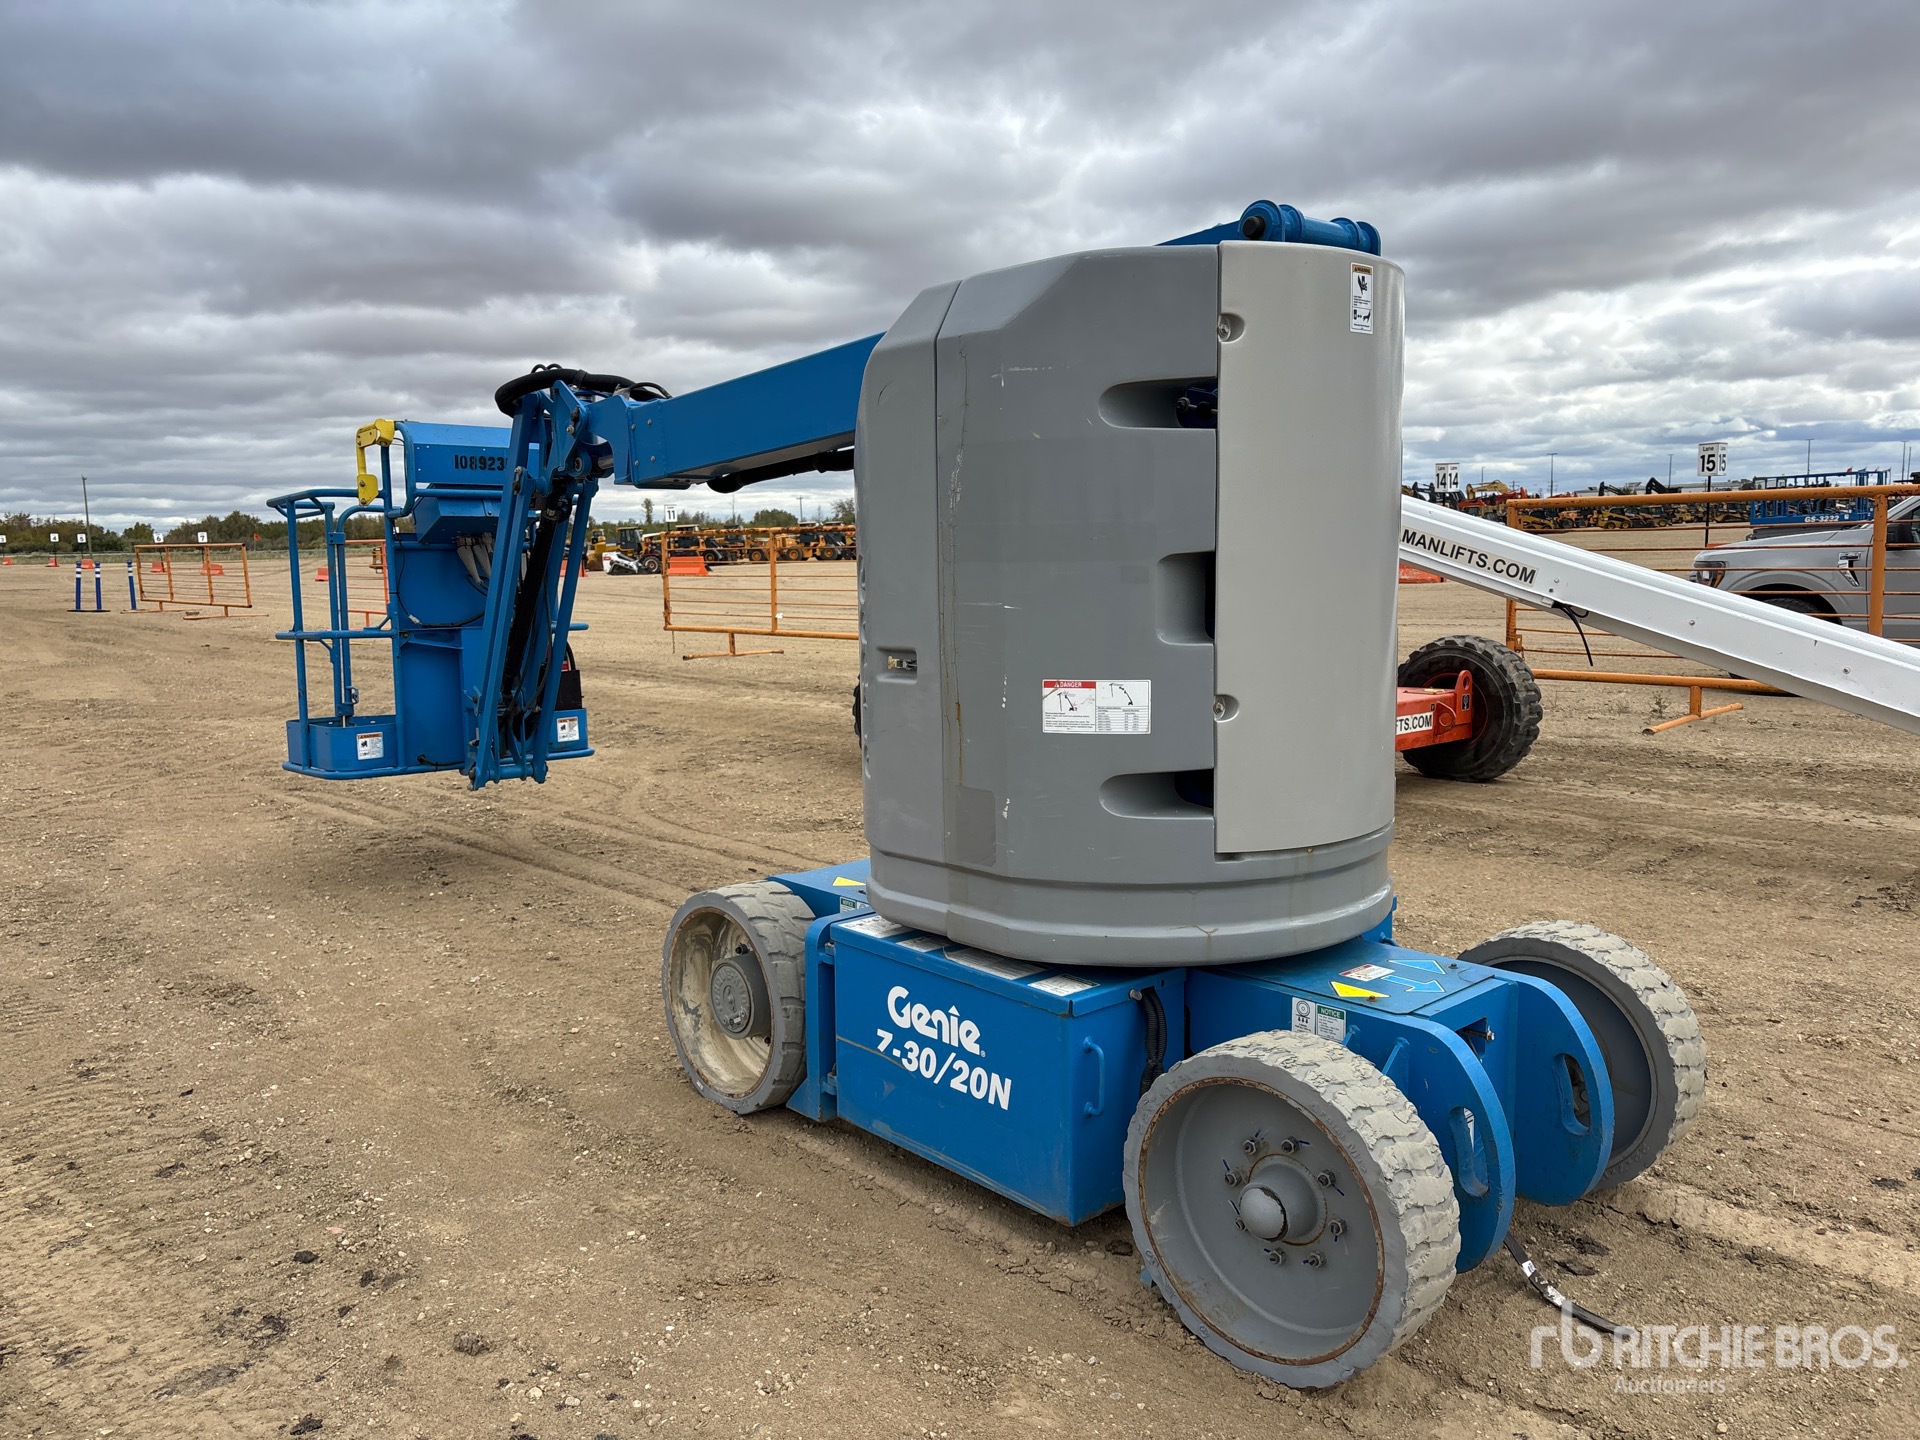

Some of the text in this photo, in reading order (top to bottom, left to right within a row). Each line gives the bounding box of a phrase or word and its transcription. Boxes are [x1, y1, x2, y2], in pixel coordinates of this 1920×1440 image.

[454, 454, 508, 471] 108923
[1700, 453, 1716, 473] 15
[1718, 453, 1727, 472] 15
[1436, 472, 1447, 489] 14
[1448, 472, 1459, 489] 14
[667, 510, 676, 520] 11
[1804, 515, 1840, 523] GS-3232
[1401, 528, 1537, 585] MANLIFTS.COM
[887, 985, 981, 1056] Genie
[1320, 1006, 1341, 1019] NOTICE
